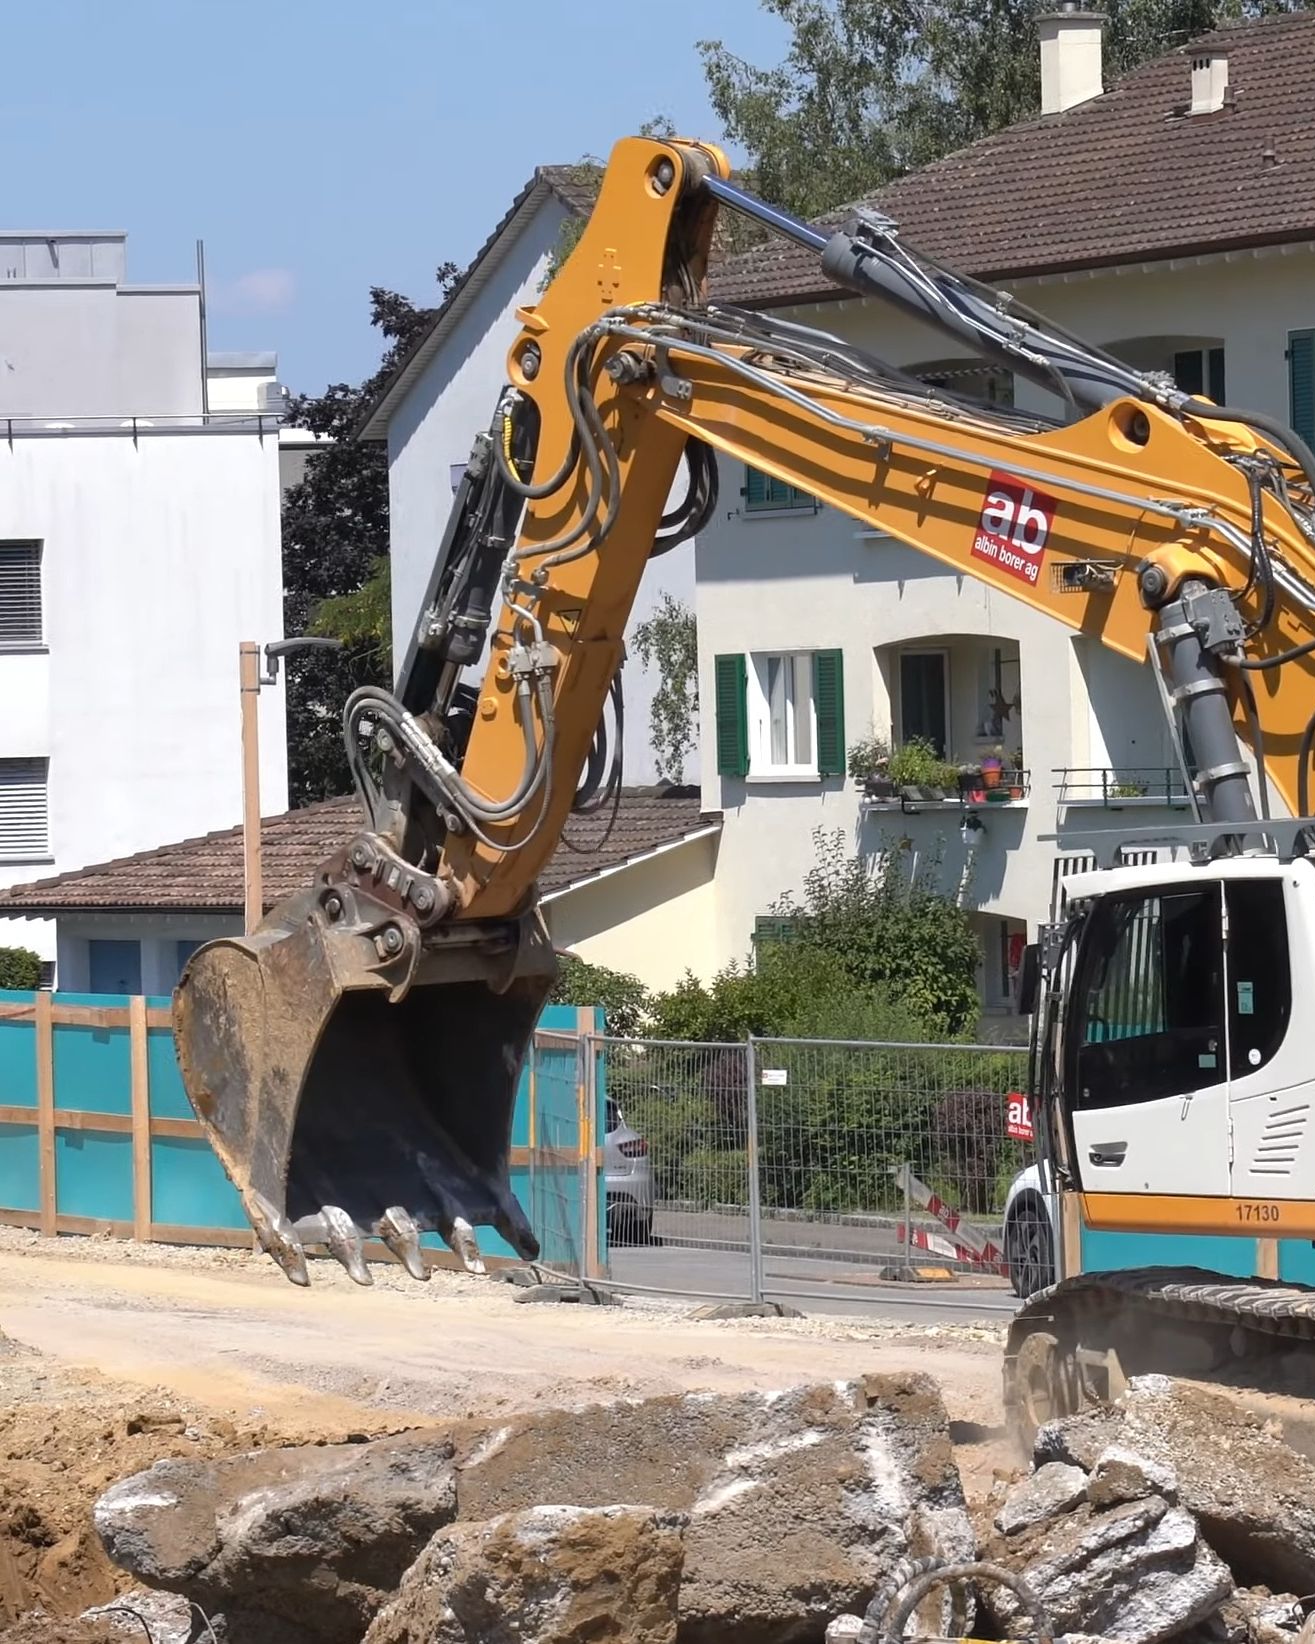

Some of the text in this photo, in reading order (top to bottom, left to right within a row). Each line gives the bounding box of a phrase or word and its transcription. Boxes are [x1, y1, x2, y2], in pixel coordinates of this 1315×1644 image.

[981, 488, 1048, 554] ab
[975, 535, 1039, 581] albin borer ag
[1236, 1204, 1279, 1221] 17130
